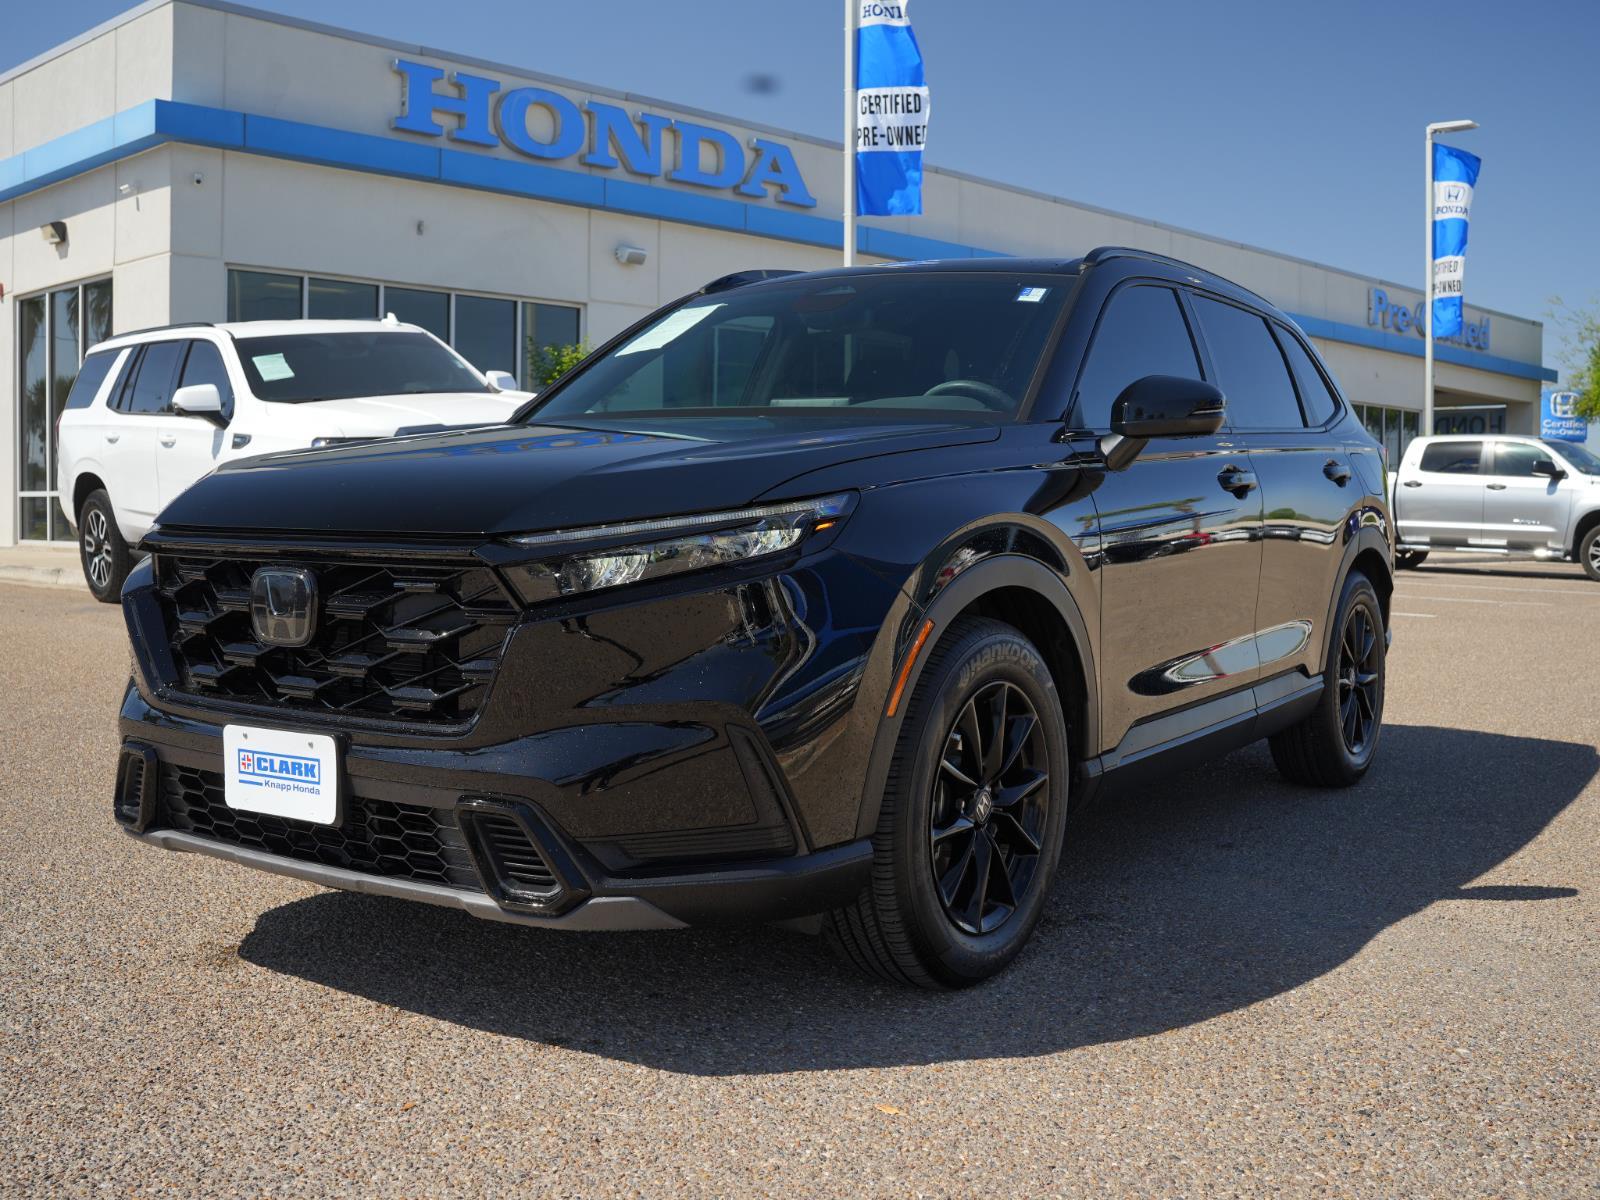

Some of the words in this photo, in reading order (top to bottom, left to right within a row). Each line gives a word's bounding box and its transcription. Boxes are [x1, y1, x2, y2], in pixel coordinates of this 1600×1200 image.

[860, 93, 921, 115] CERTIFIED
[391, 58, 817, 208] HONDA
[256, 757, 317, 778] CLARK
[264, 780, 292, 792] Knapp
[293, 785, 320, 795] Honda
